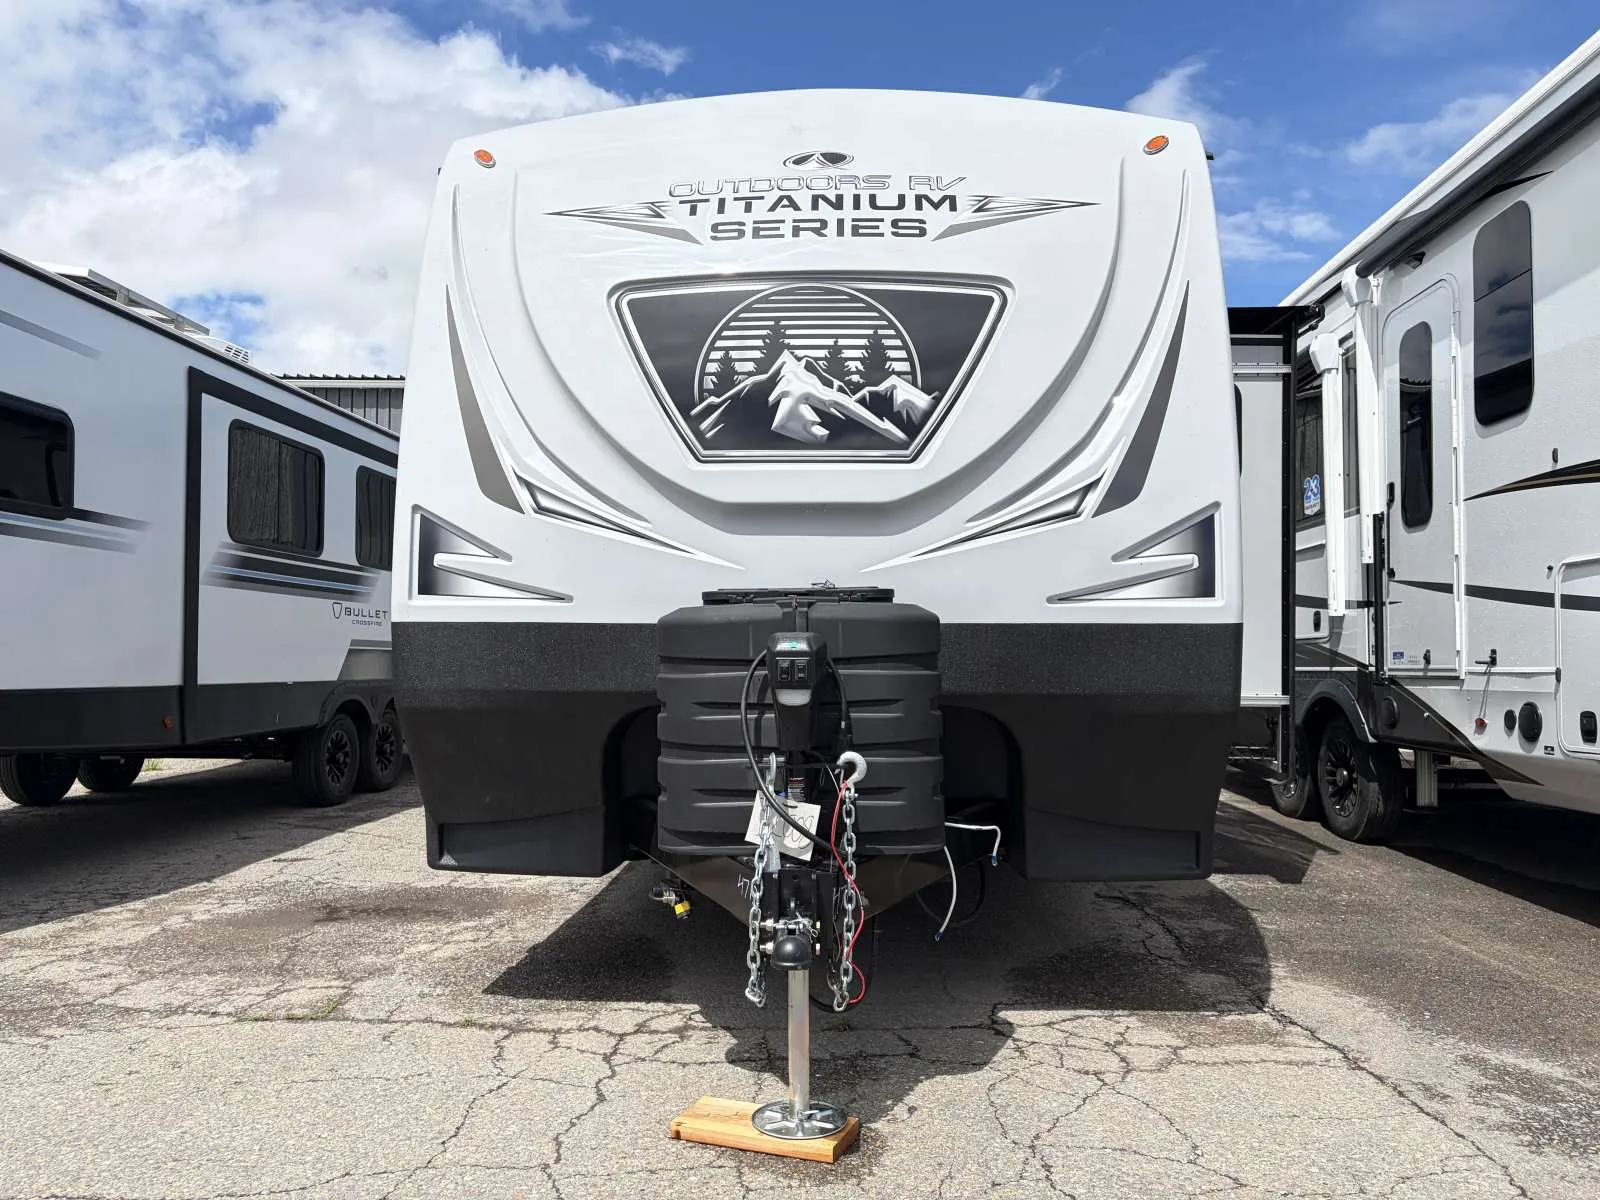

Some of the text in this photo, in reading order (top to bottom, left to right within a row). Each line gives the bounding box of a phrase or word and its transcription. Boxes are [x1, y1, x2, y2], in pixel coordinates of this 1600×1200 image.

[669, 174, 967, 198] OUTDOORS RV
[678, 193, 958, 217] TITANIUM
[710, 217, 927, 241] SERIES
[344, 606, 388, 619] BULLET
